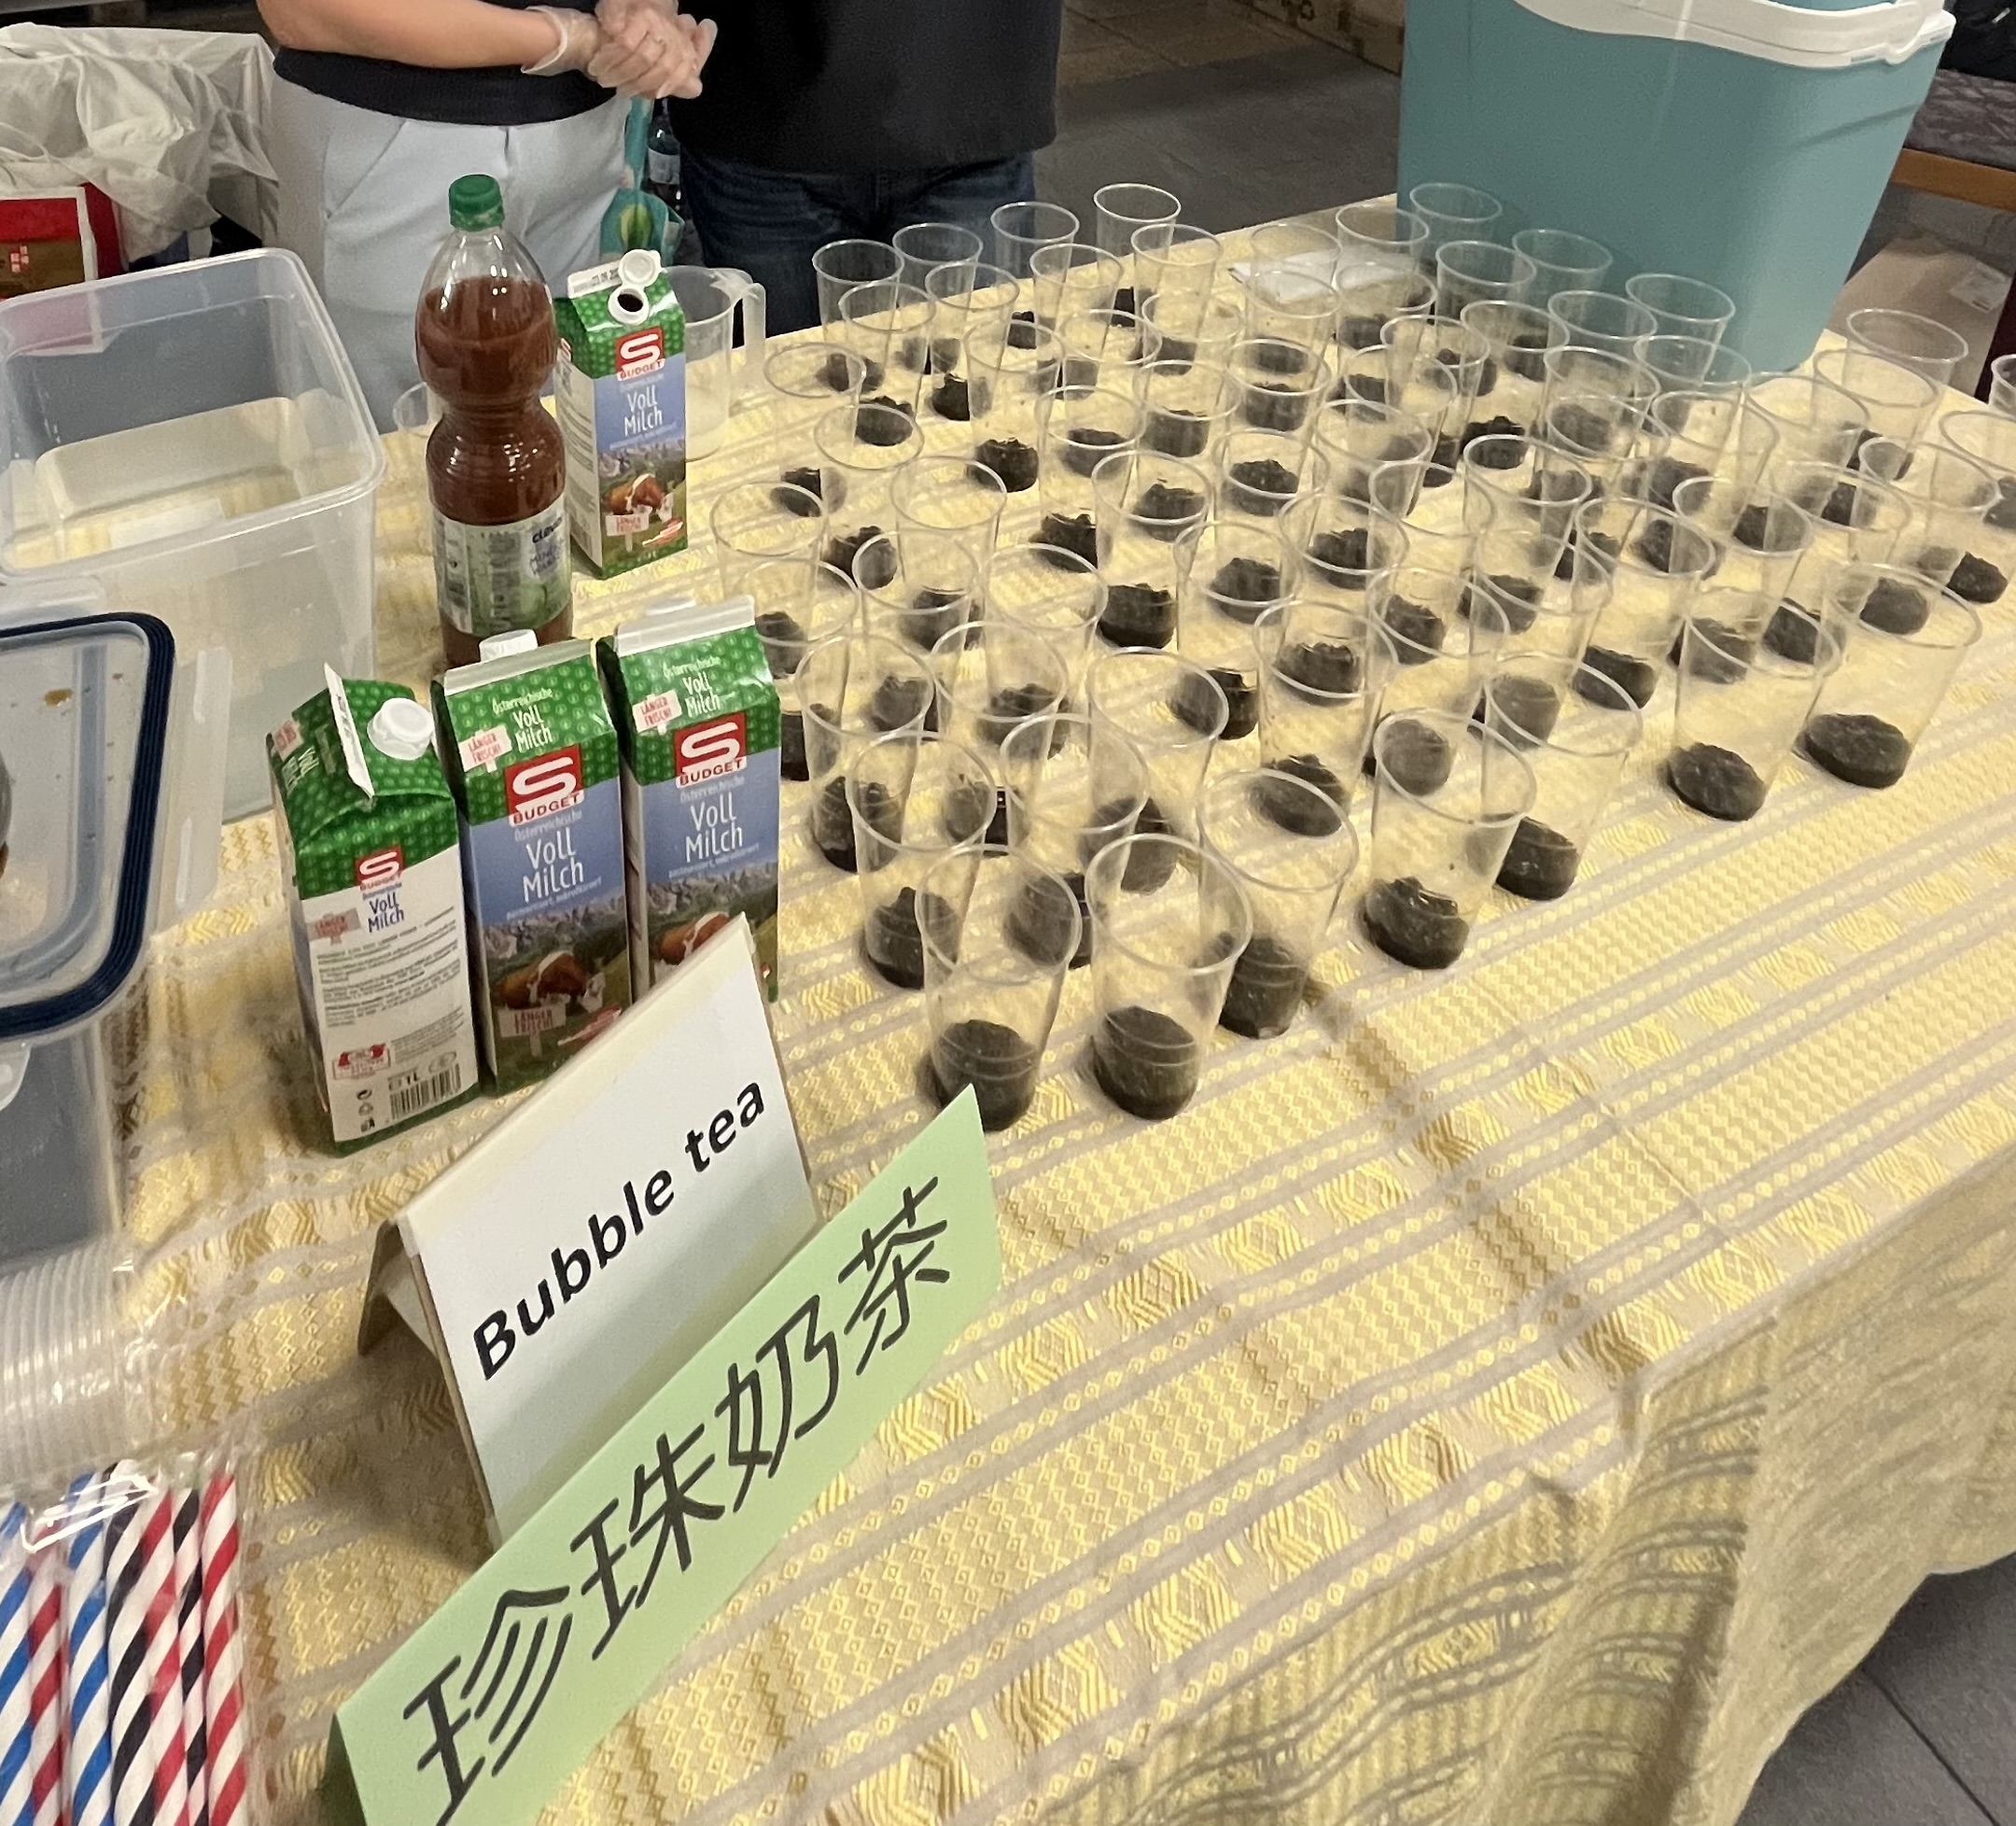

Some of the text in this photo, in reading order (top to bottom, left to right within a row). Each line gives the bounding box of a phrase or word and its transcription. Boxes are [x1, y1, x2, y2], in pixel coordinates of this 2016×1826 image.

[620, 360, 661, 379] BUDGET
[627, 384, 657, 413] Voll
[624, 405, 663, 436] Milch
[682, 671, 712, 695] Voll
[512, 705, 544, 729] Voll
[685, 691, 721, 718] Milch
[514, 723, 553, 752] Milch
[679, 759, 742, 785] BUDGET
[513, 792, 580, 825] BUDGET
[690, 792, 736, 832] Voll
[525, 827, 576, 870] Voll
[685, 822, 743, 863] Milch
[360, 871, 401, 892] BUDGET
[523, 857, 584, 903] Milch
[369, 892, 399, 915] Voll
[368, 906, 404, 933] Milch
[473, 1082, 764, 1381] Bubble tea
[403, 1175, 949, 1826] 珍珠奶茶
